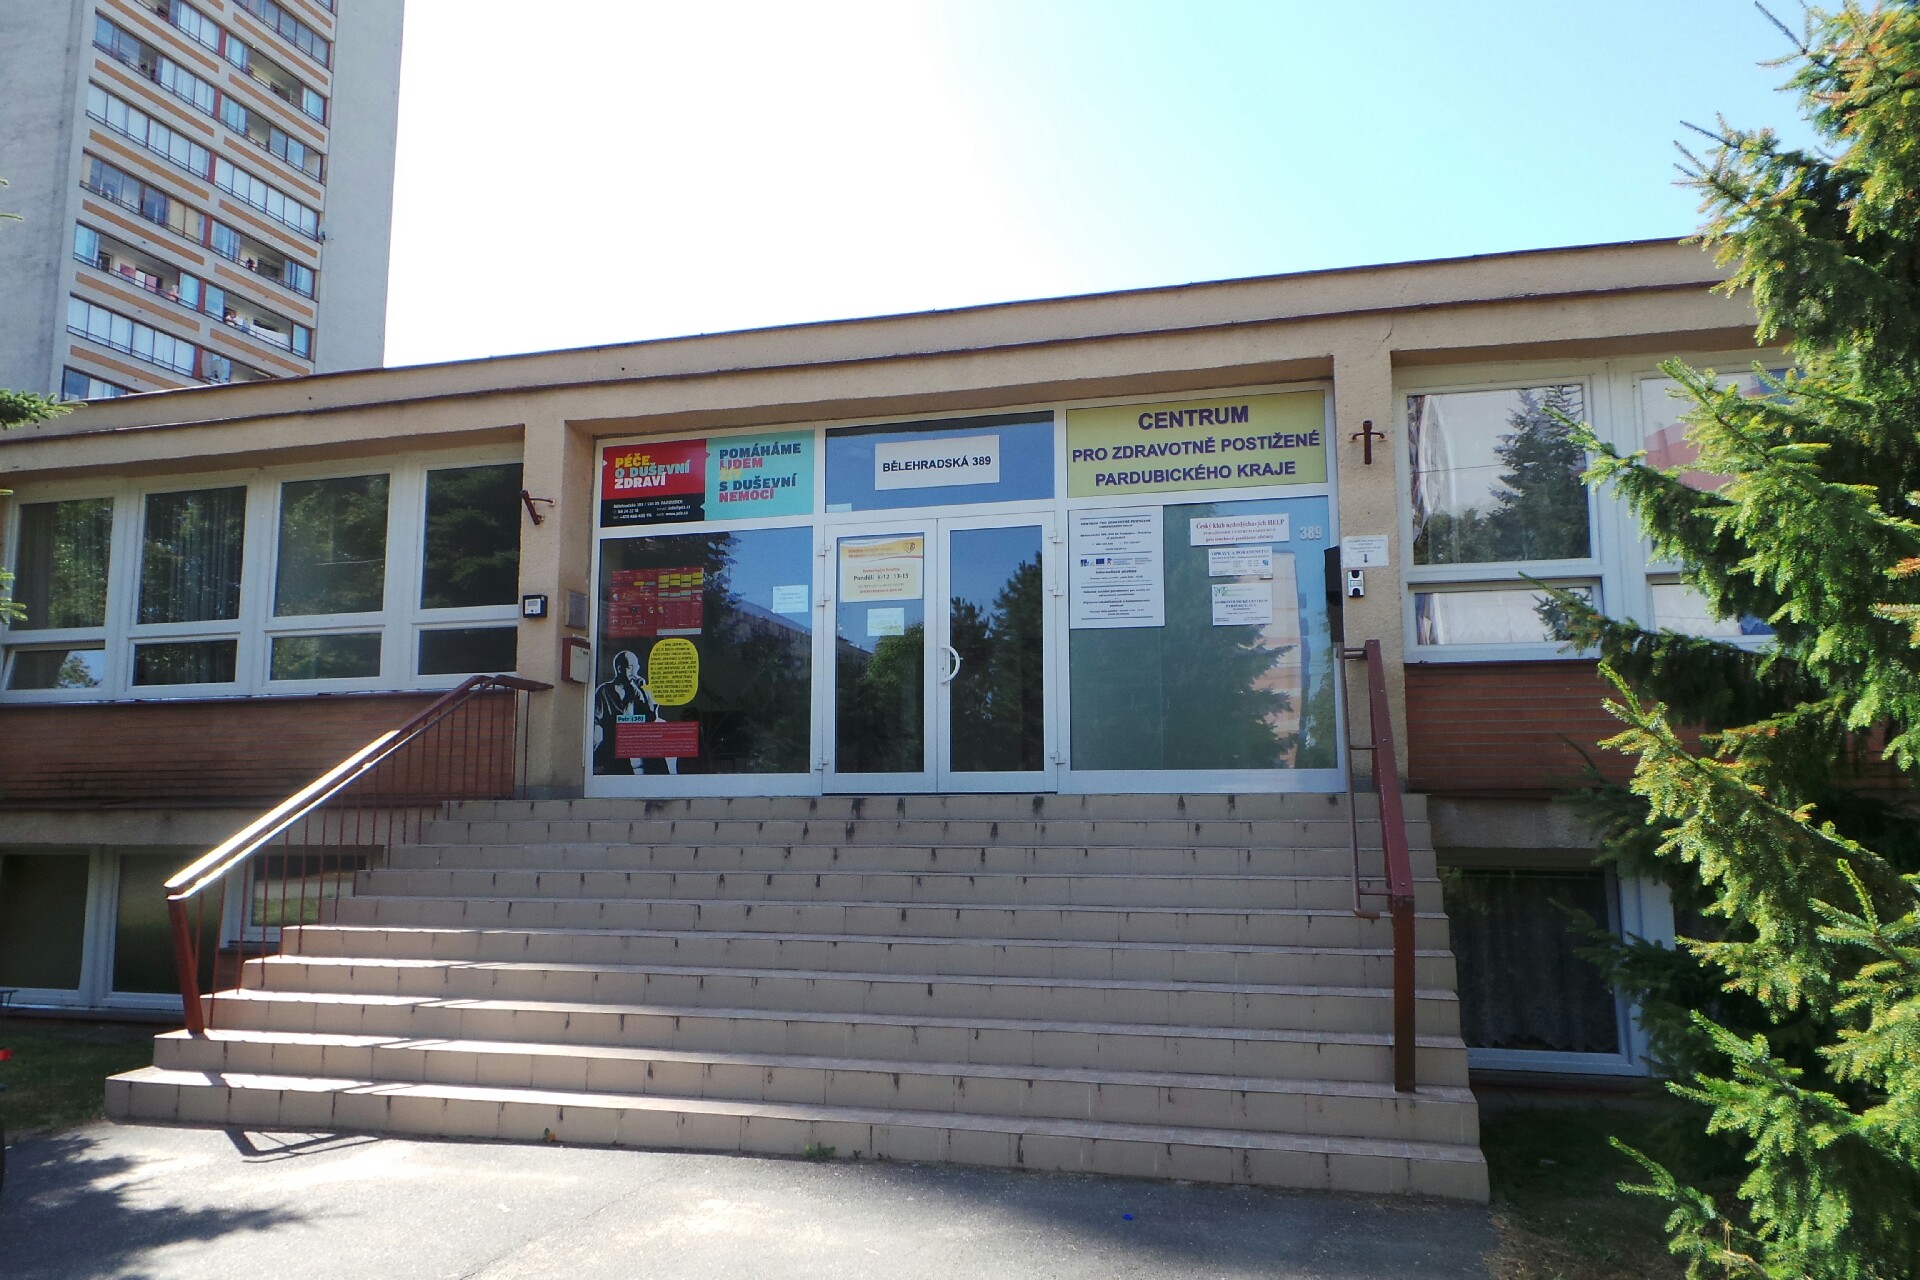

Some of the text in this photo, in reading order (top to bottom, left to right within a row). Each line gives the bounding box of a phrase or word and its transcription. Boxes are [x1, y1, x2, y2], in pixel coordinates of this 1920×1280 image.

[1138, 405, 1249, 431] CENTRUM
[719, 441, 802, 460] POMÁHÁME
[1072, 429, 1320, 463] PRO ZDRAVOTNĚ POSTIŽENÉ
[614, 459, 692, 479] O DUŠEVNÍ
[615, 452, 651, 468] PÉČE
[719, 457, 764, 471] LIDEM
[882, 455, 991, 472] BĚLEHRADSKÁ 389
[614, 471, 667, 490] ZDRAVÍ
[719, 473, 798, 492] S DUŠEVNÍ
[1095, 461, 1296, 487] PARDUBICKÉHO KRAJE
[718, 486, 777, 503] NEMOCÍ
[1196, 522, 1212, 530] Český
[1300, 526, 1322, 540] 389
